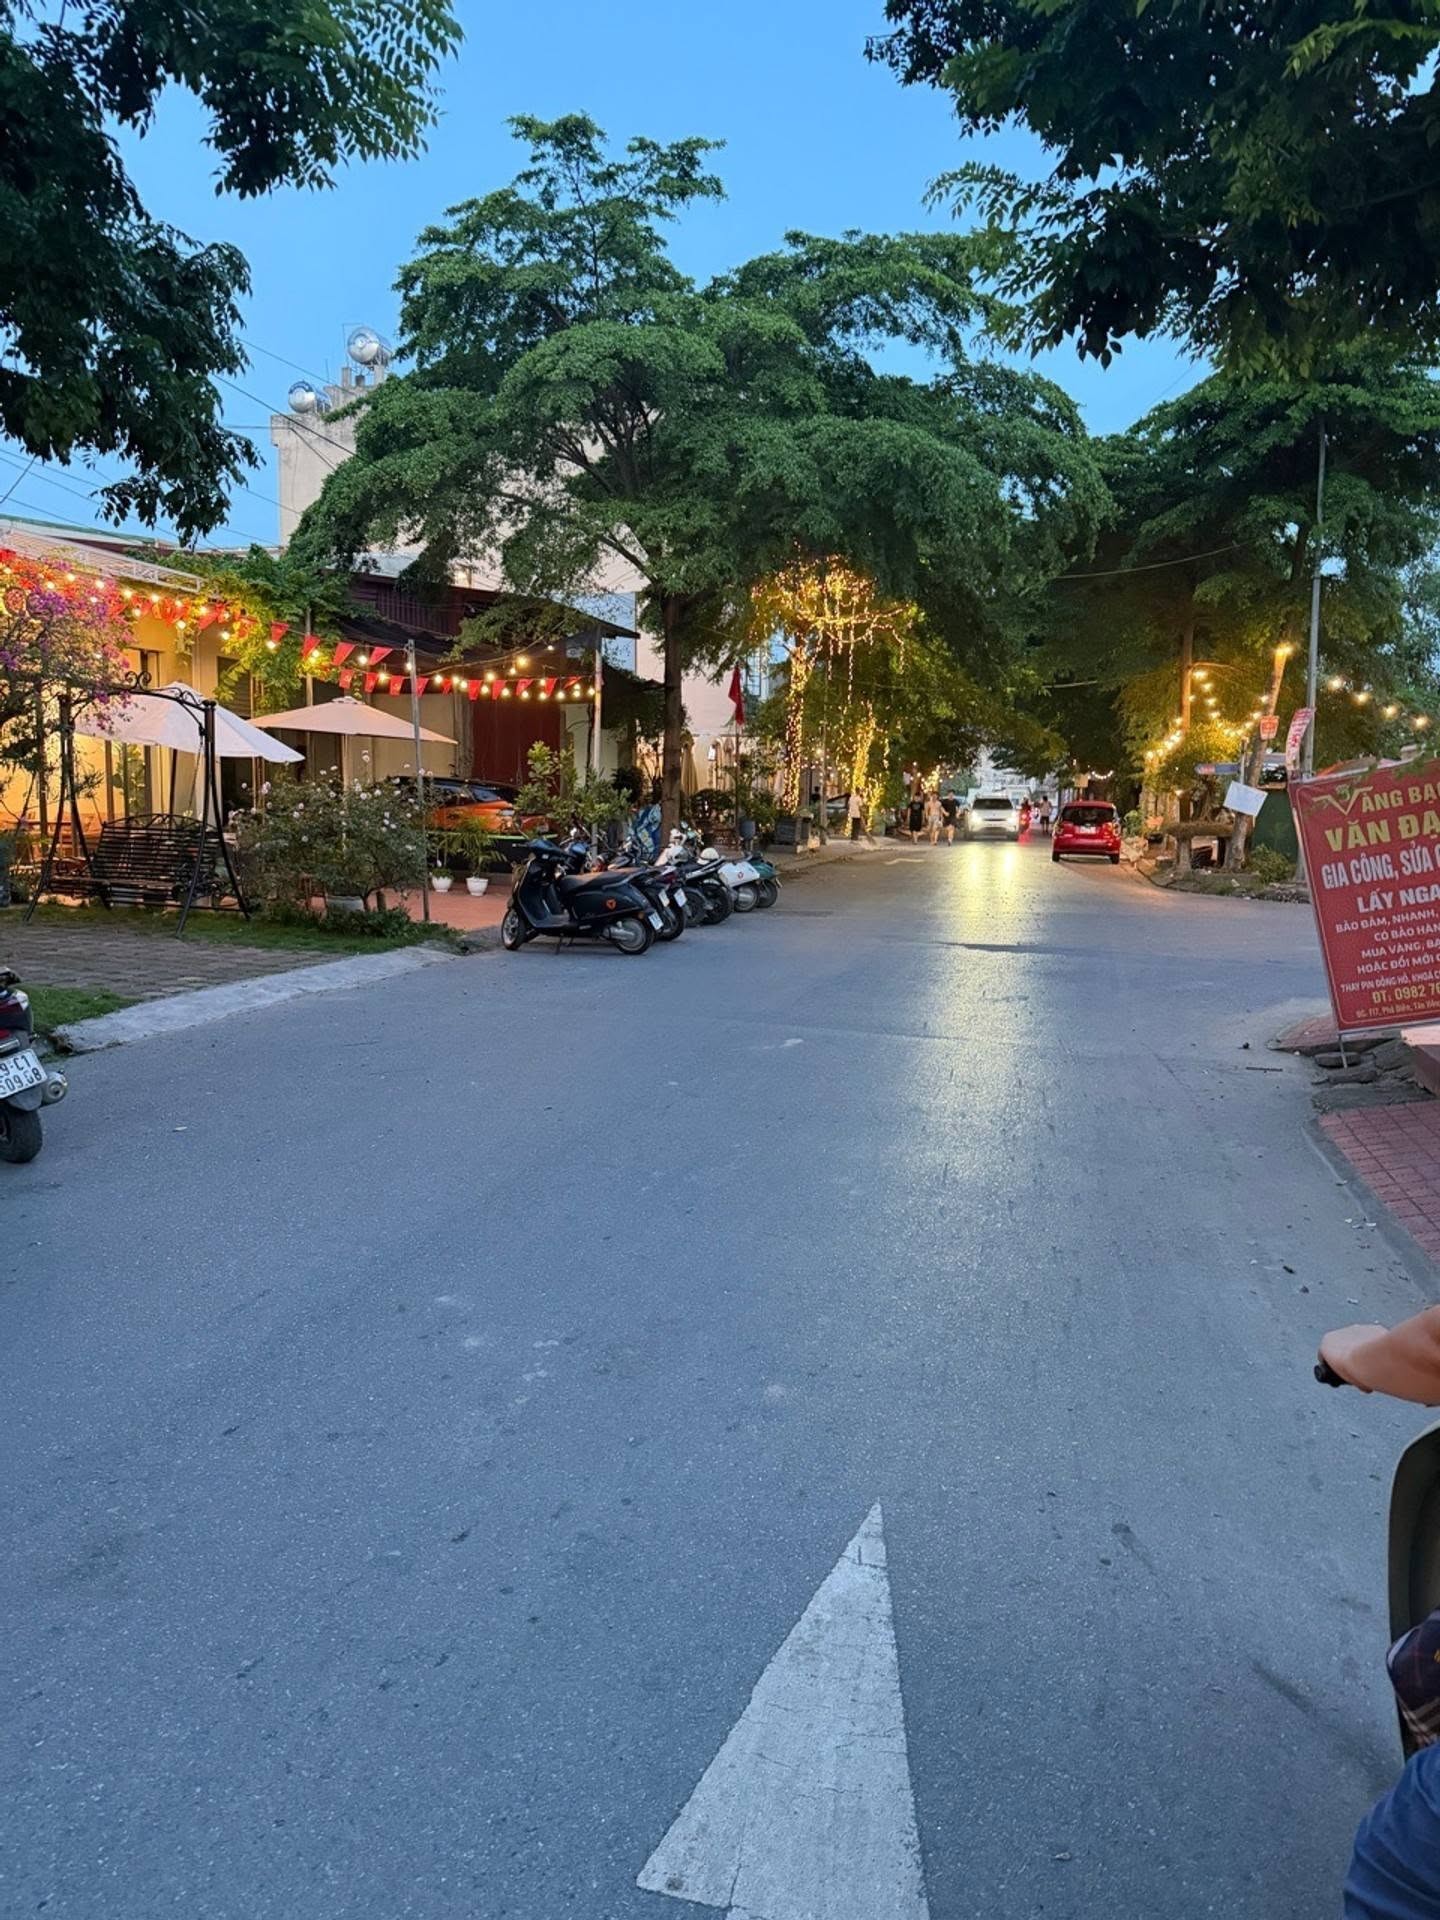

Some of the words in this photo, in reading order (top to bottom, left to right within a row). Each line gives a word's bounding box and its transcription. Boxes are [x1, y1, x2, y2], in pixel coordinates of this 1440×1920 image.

[1408, 782, 1440, 804] BẠ
[1325, 819, 1391, 851] VĂN
[1321, 862, 1350, 890] GIA
[1350, 852, 1399, 884] CÔNG,
[1400, 840, 1434, 876] SỬA
[1357, 888, 1393, 913] LẤY
[1400, 884, 1440, 906] NGA
[1391, 926, 1414, 939] BẢO
[1361, 947, 1387, 959] MUA
[1341, 982, 1360, 993] THAY
[1360, 980, 1375, 990] PIN
[1394, 984, 1426, 1001] 0982
[0, 1055, 31, 1078] 9-C1
